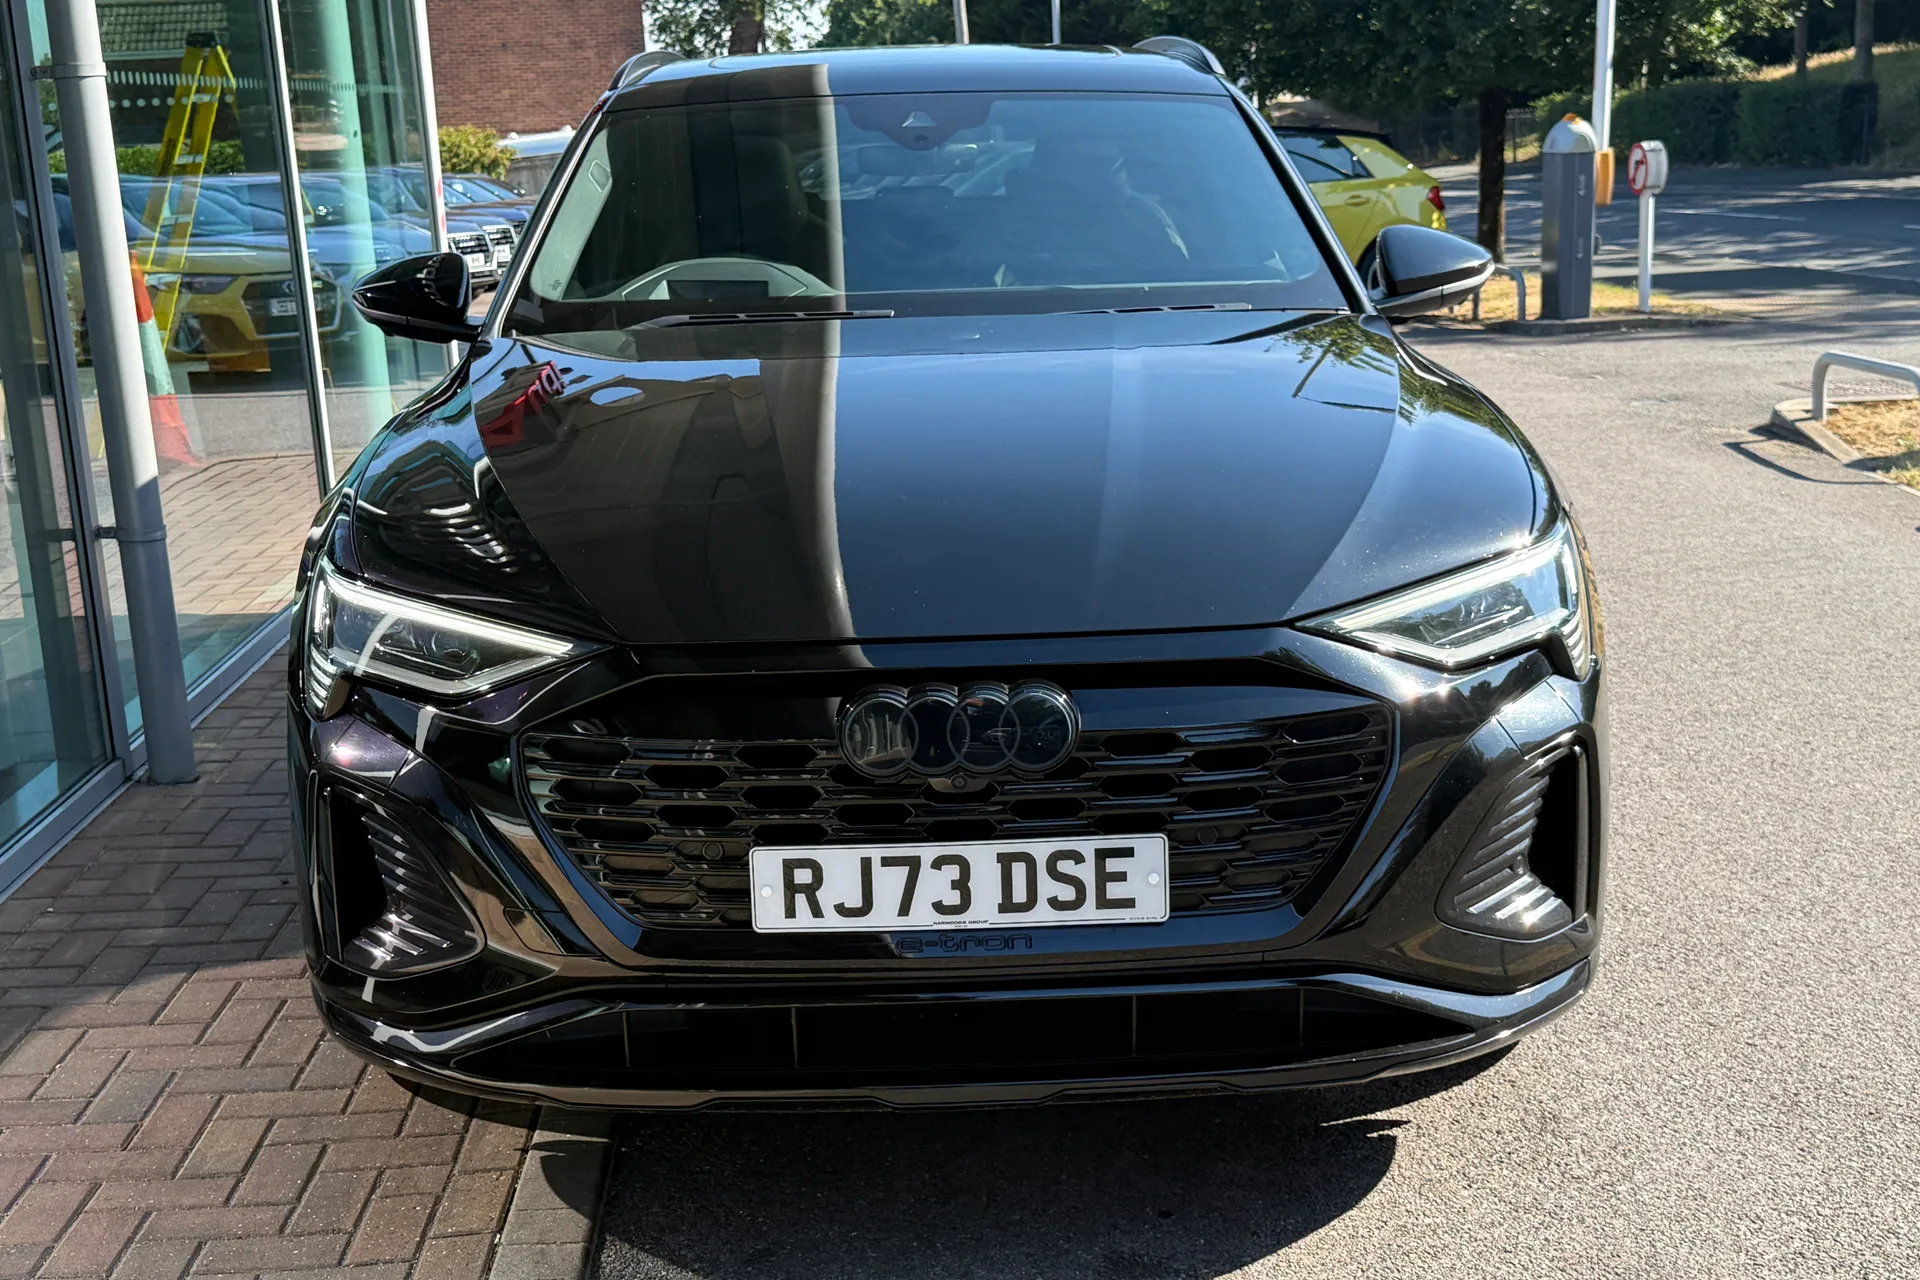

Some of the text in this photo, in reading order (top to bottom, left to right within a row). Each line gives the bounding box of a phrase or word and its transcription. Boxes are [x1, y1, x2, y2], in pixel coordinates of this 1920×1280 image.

[781, 846, 1137, 919] RJ73 DSE
[895, 932, 1033, 954] e-tron
